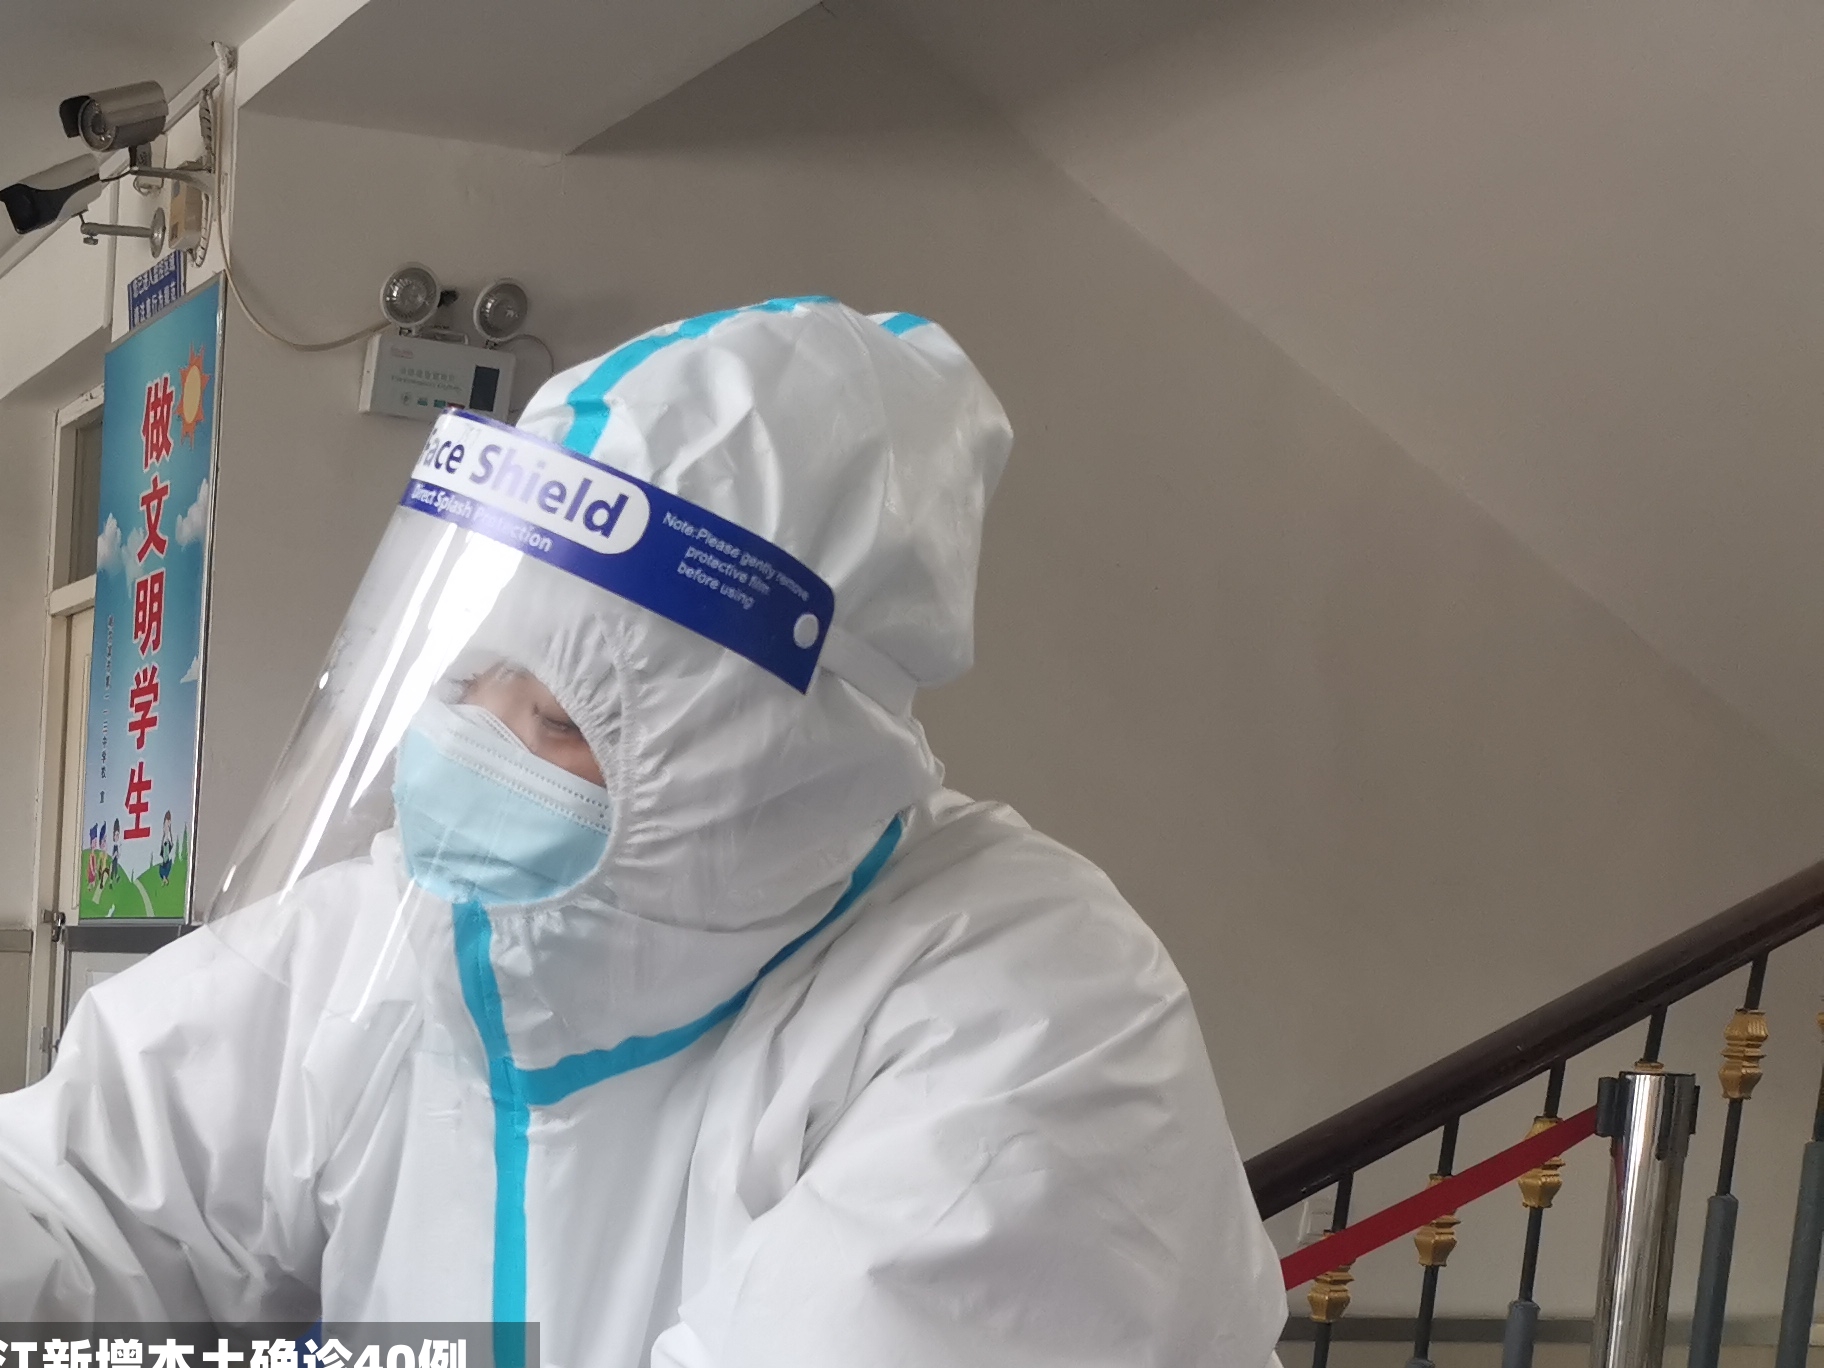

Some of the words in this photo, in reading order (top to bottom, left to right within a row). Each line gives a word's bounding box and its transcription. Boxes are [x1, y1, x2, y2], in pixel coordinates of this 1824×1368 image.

[416, 427, 466, 475] ace
[469, 444, 630, 538] Shield
[433, 490, 474, 519] Splash
[676, 560, 722, 591] before
[719, 583, 756, 611] using
[684, 545, 750, 585] protective
[123, 376, 174, 841] 做文明学生
